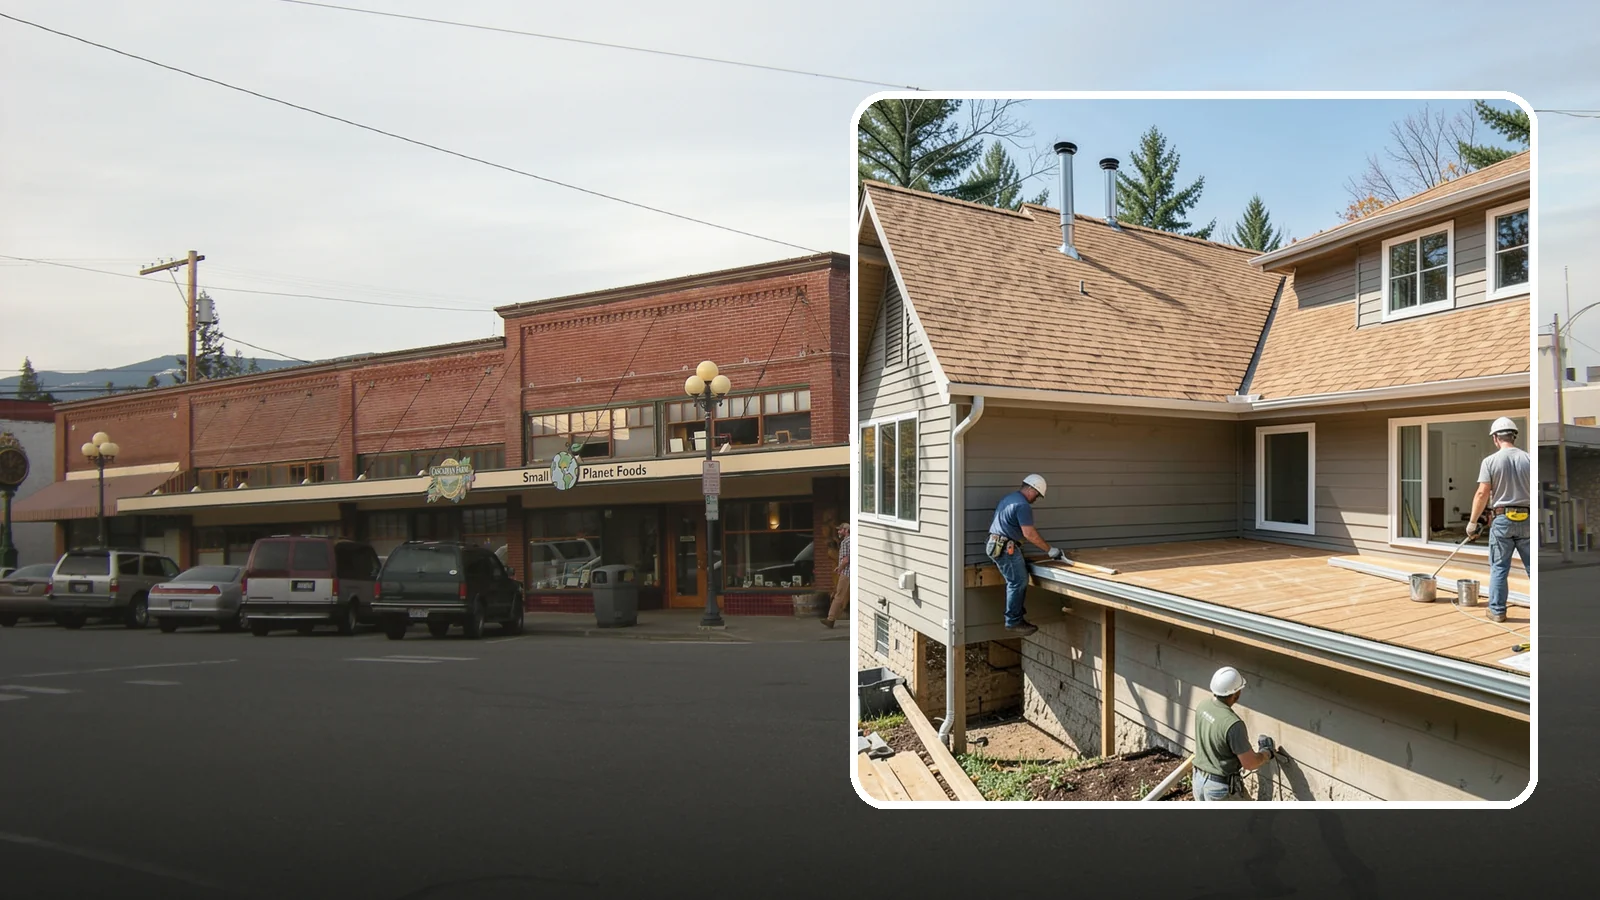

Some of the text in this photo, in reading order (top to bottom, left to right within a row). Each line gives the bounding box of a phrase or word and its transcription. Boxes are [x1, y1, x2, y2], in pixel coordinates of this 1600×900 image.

[523, 465, 647, 483] Small Planet Foods
